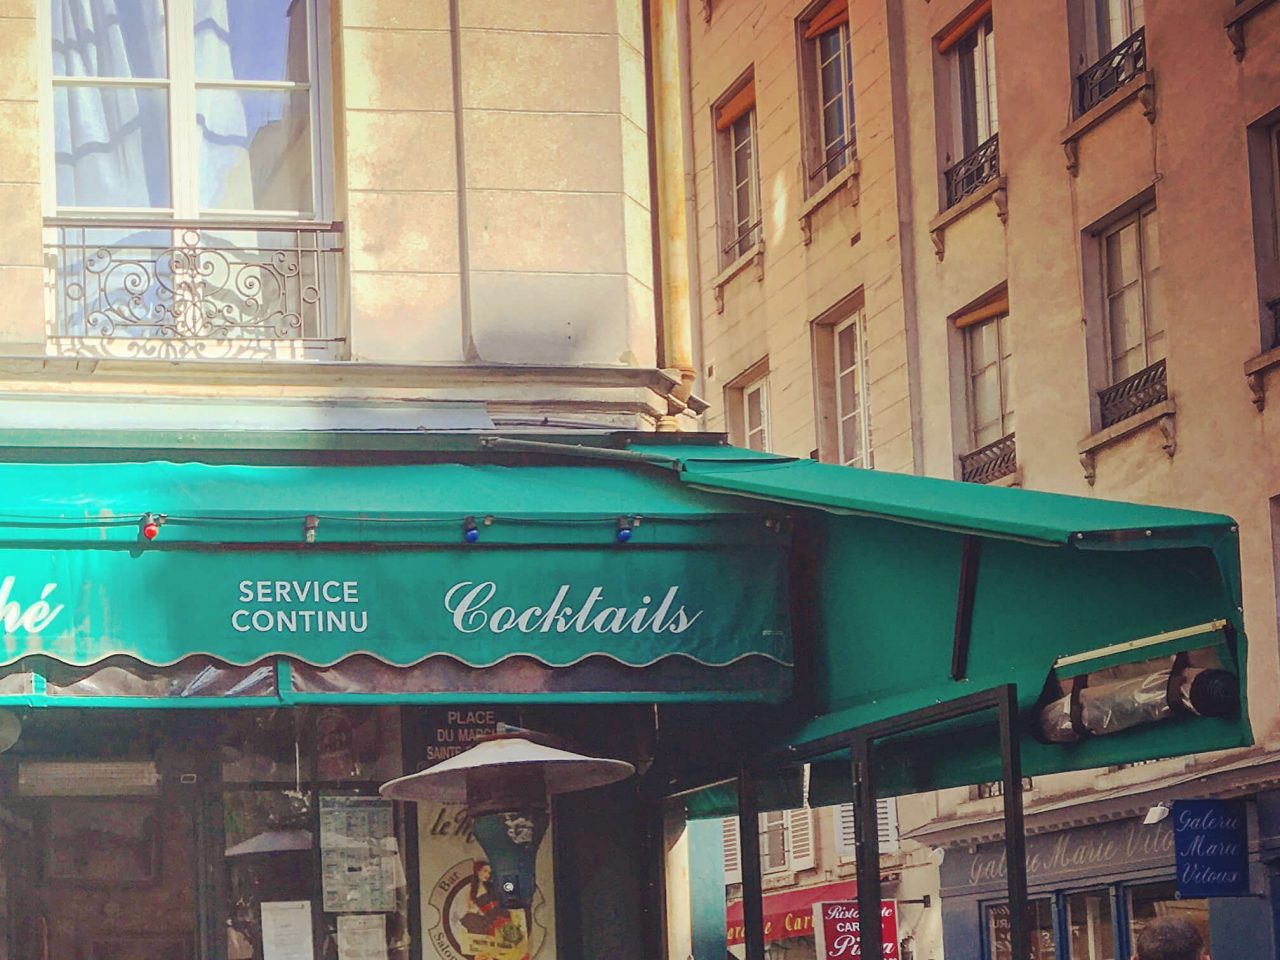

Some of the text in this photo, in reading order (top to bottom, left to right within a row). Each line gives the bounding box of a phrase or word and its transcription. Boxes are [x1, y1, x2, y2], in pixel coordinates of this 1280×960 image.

[238, 580, 359, 603] SERVICE
[443, 580, 703, 634] Cocktails
[230, 609, 368, 633] CONTINU
[448, 711, 496, 725] PLACE
[437, 728, 455, 743] DU
[1177, 809, 1241, 833] Galerie
[1181, 839, 1240, 858] Marie
[439, 870, 461, 893] Bar
